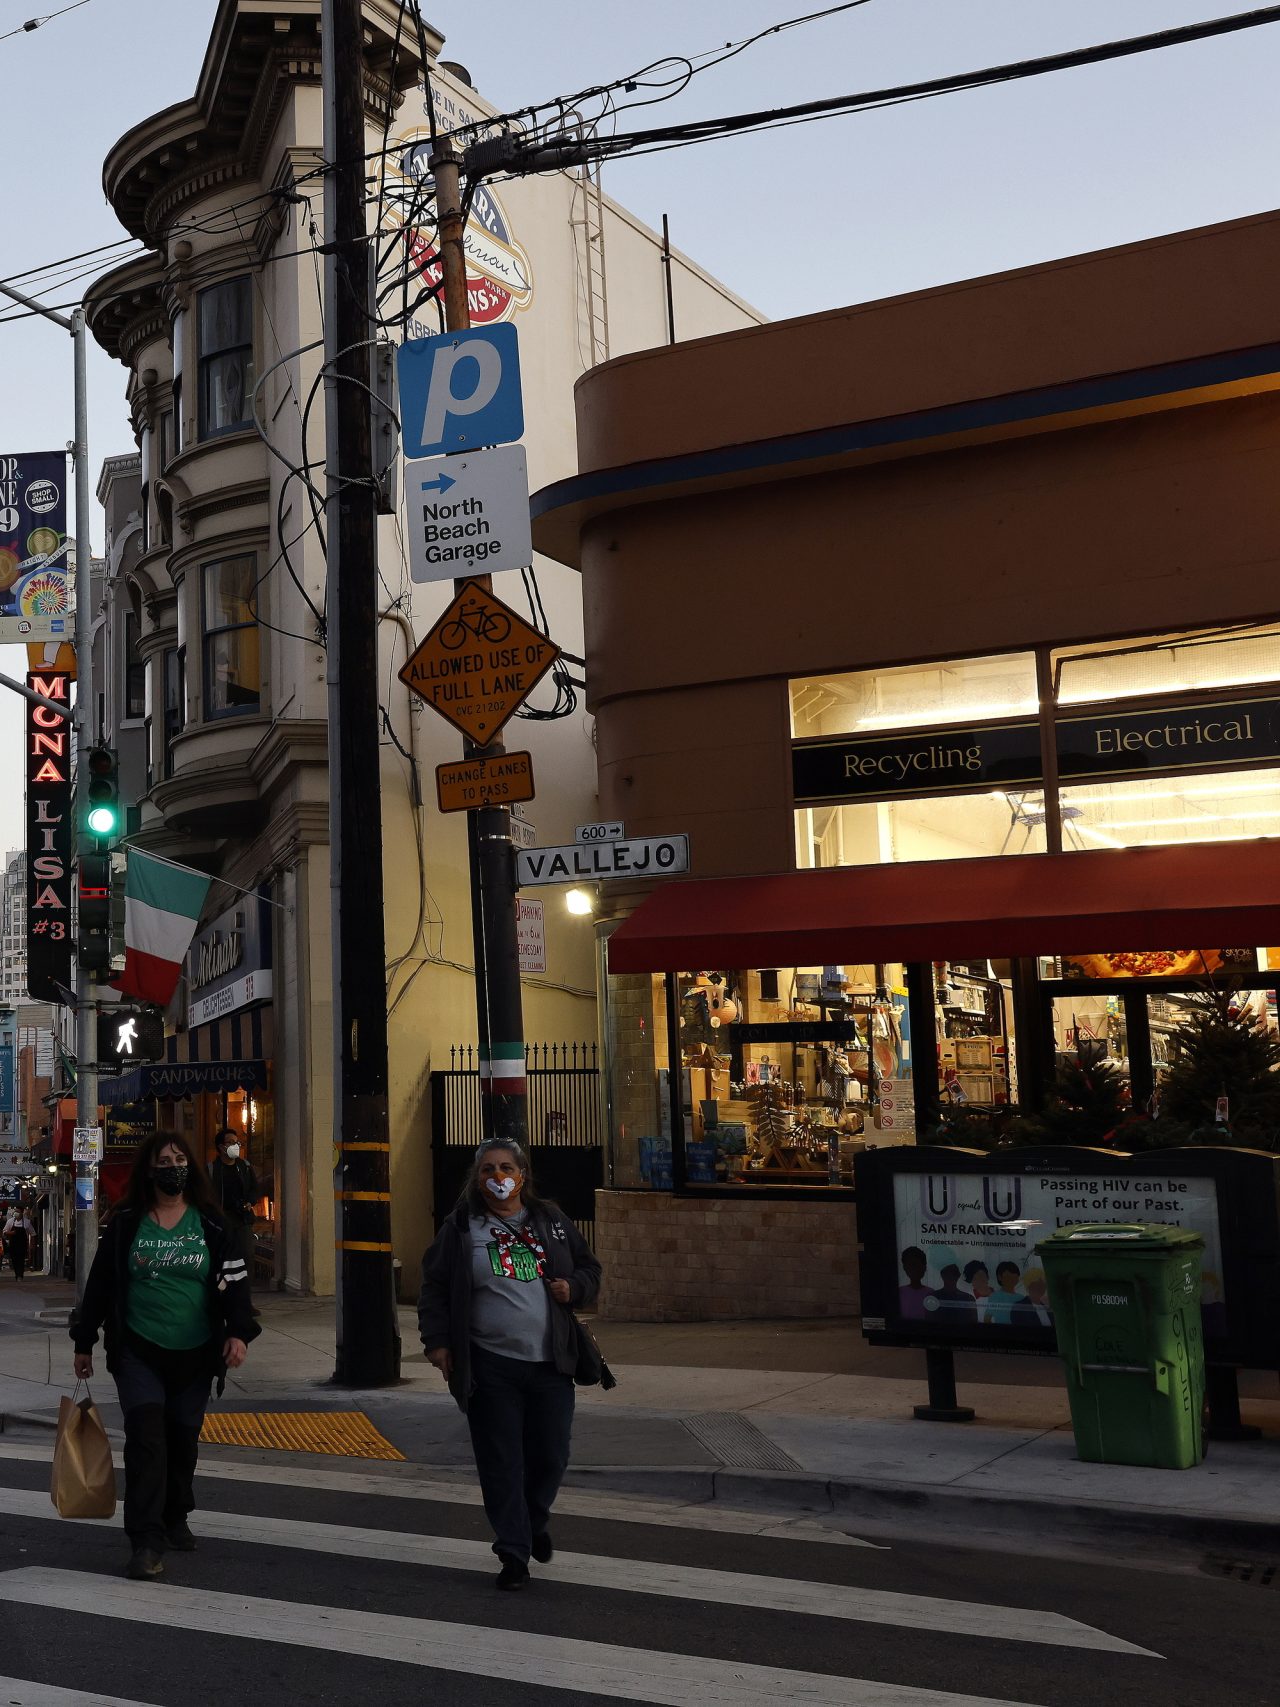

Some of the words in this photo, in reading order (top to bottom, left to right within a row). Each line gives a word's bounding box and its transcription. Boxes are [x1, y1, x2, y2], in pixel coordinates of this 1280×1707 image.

[423, 101, 455, 132] SNCE
[484, 280, 507, 299] MARK
[31, 494, 54, 504] SMALL
[32, 488, 51, 499] SHOP
[423, 498, 483, 522] North
[424, 518, 490, 543] Beach
[425, 540, 502, 564] Garage
[410, 653, 483, 682] ALLOWED
[489, 647, 521, 670] USE
[525, 643, 546, 665] OF
[432, 680, 473, 704] FULL
[480, 672, 527, 697] LANE
[475, 700, 506, 714] 21202
[30, 676, 67, 782] MONA
[1095, 714, 1255, 755] Electrical
[844, 745, 983, 780] Recycling
[441, 766, 487, 786] CHANGE
[489, 761, 528, 778] LANES
[462, 785, 476, 801] TO
[480, 783, 510, 797] PASS
[581, 825, 607, 840] 600
[31, 800, 67, 909] LISA
[526, 843, 675, 878] VALLEJO
[521, 905, 542, 921] PARKING
[32, 919, 66, 940] #3
[518, 943, 542, 957] EDNESDAY
[150, 1066, 256, 1086] SANDWICHES
[1040, 1178, 1098, 1194] Passing
[1102, 1180, 1130, 1192] HIV
[1134, 1182, 1162, 1192] can
[1167, 1180, 1188, 1192] be
[957, 1200, 982, 1211] equals
[1056, 1196, 1088, 1208] Part
[1092, 1197, 1108, 1209] of
[1112, 1200, 1138, 1210] our
[1144, 1198, 1184, 1211] Past.
[921, 1224, 947, 1234] SAN
[158, 1239, 184, 1248] DRINK
[920, 1238, 964, 1246] Undetectable
[970, 1240, 1026, 1248] Untransmittable
